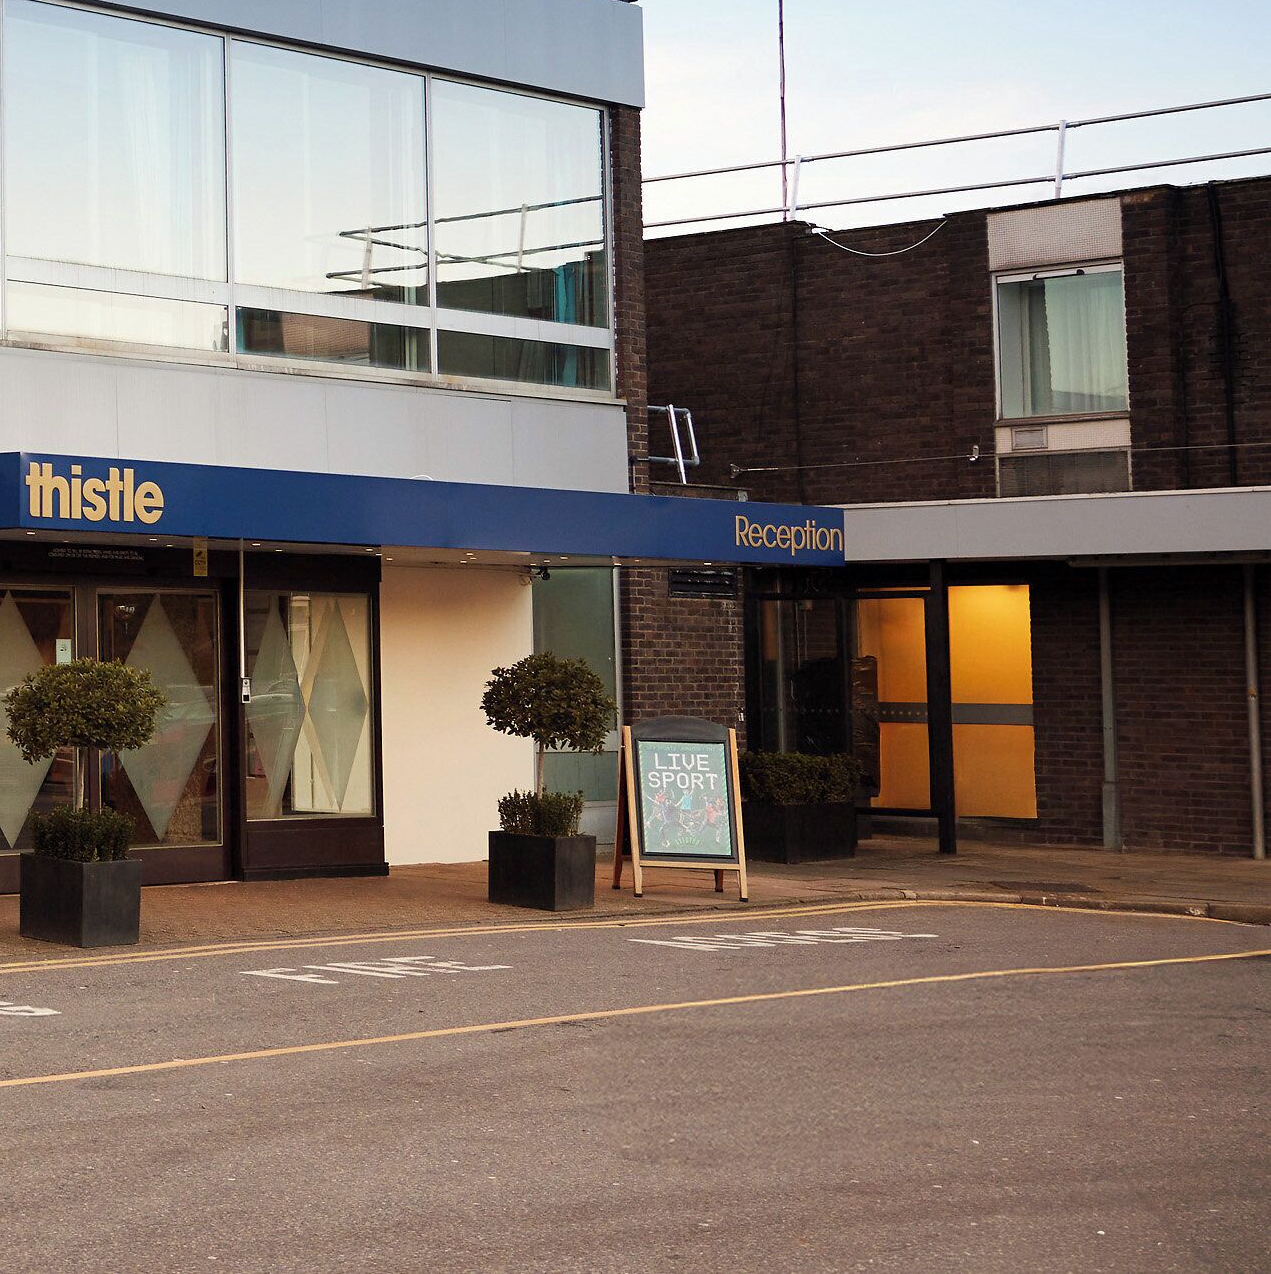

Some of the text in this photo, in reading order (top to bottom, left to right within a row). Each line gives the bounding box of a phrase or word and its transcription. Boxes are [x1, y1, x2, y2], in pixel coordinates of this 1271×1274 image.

[25, 462, 166, 524] thistle
[734, 515, 844, 556] Reception
[654, 753, 711, 771] LIVE
[648, 771, 718, 790] SPORT
[238, 955, 513, 984] FIRE
